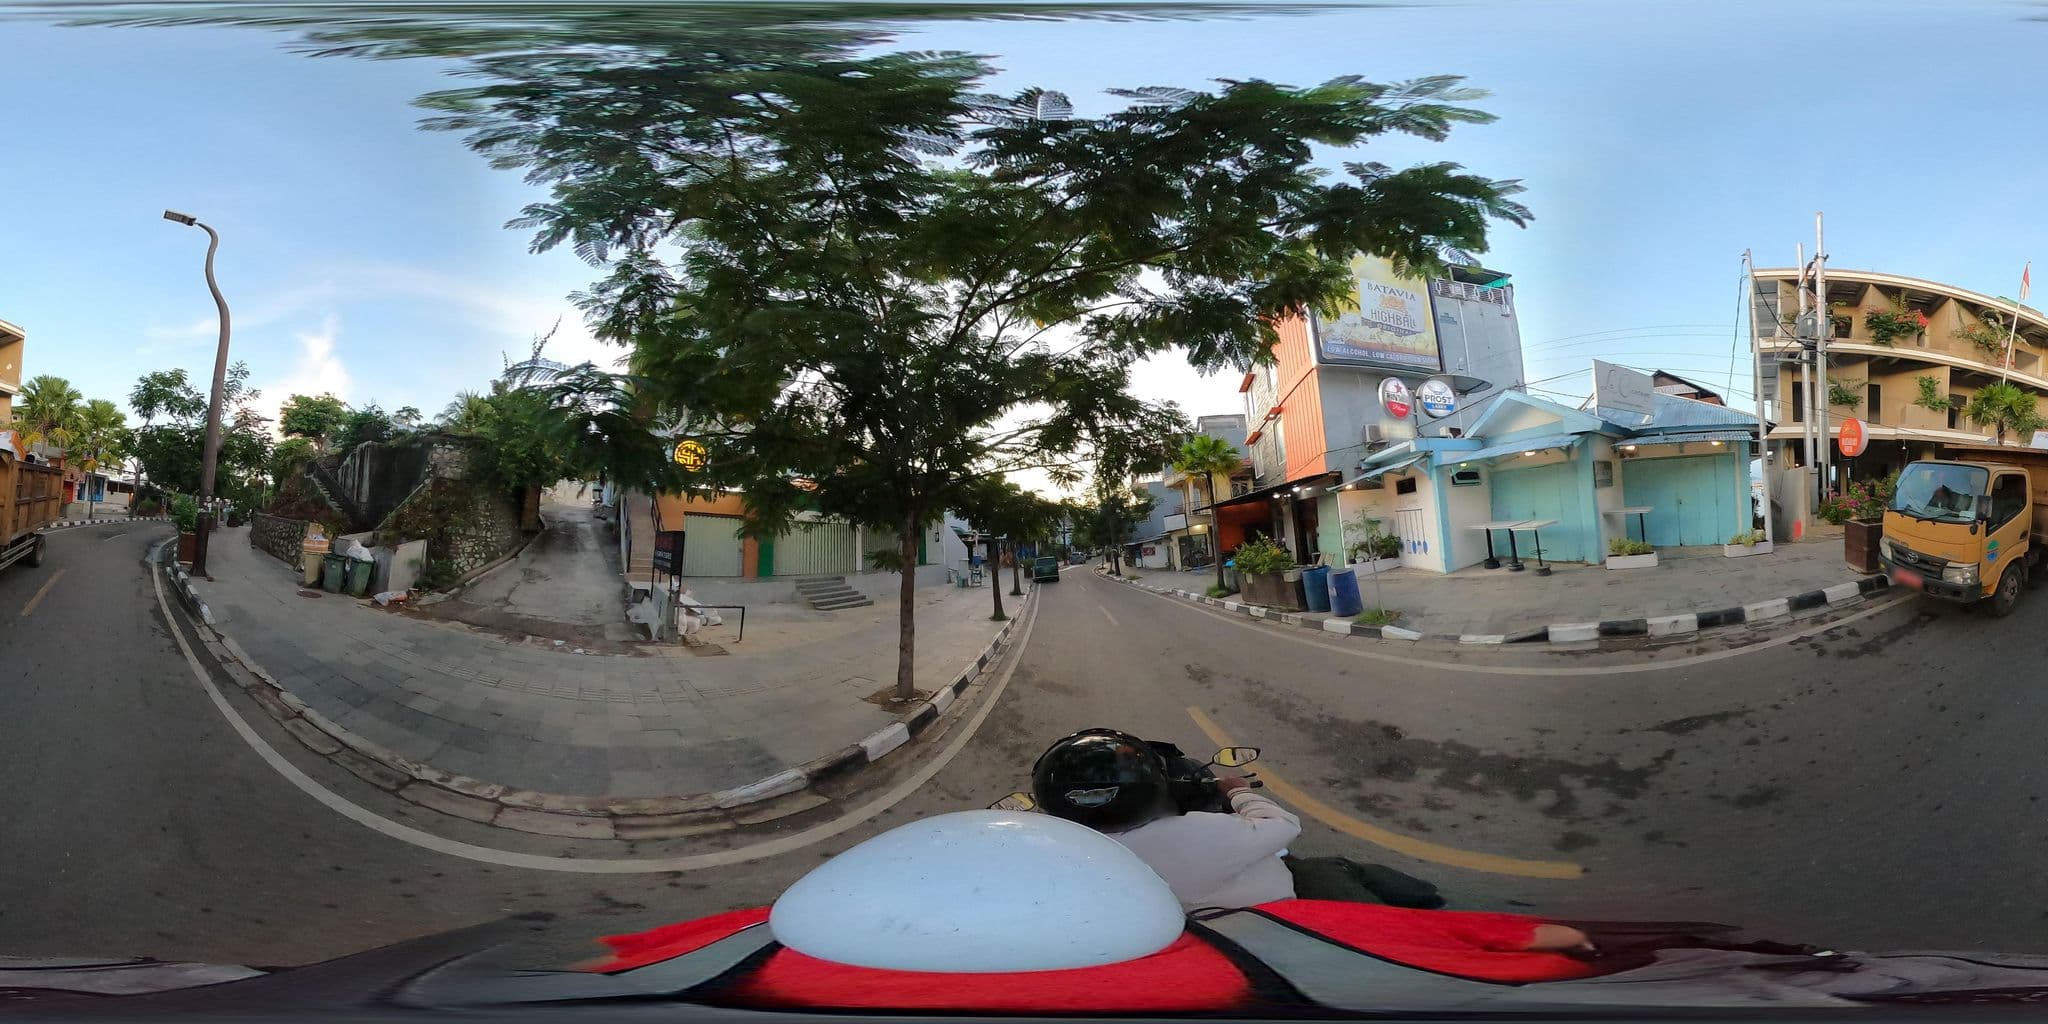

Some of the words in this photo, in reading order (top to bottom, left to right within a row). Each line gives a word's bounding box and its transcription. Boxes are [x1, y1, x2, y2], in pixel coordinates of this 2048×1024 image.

[1367, 282, 1416, 302] BATAVIA
[1370, 309, 1417, 329] HIGHBALL
[1424, 394, 1453, 404] PROST
